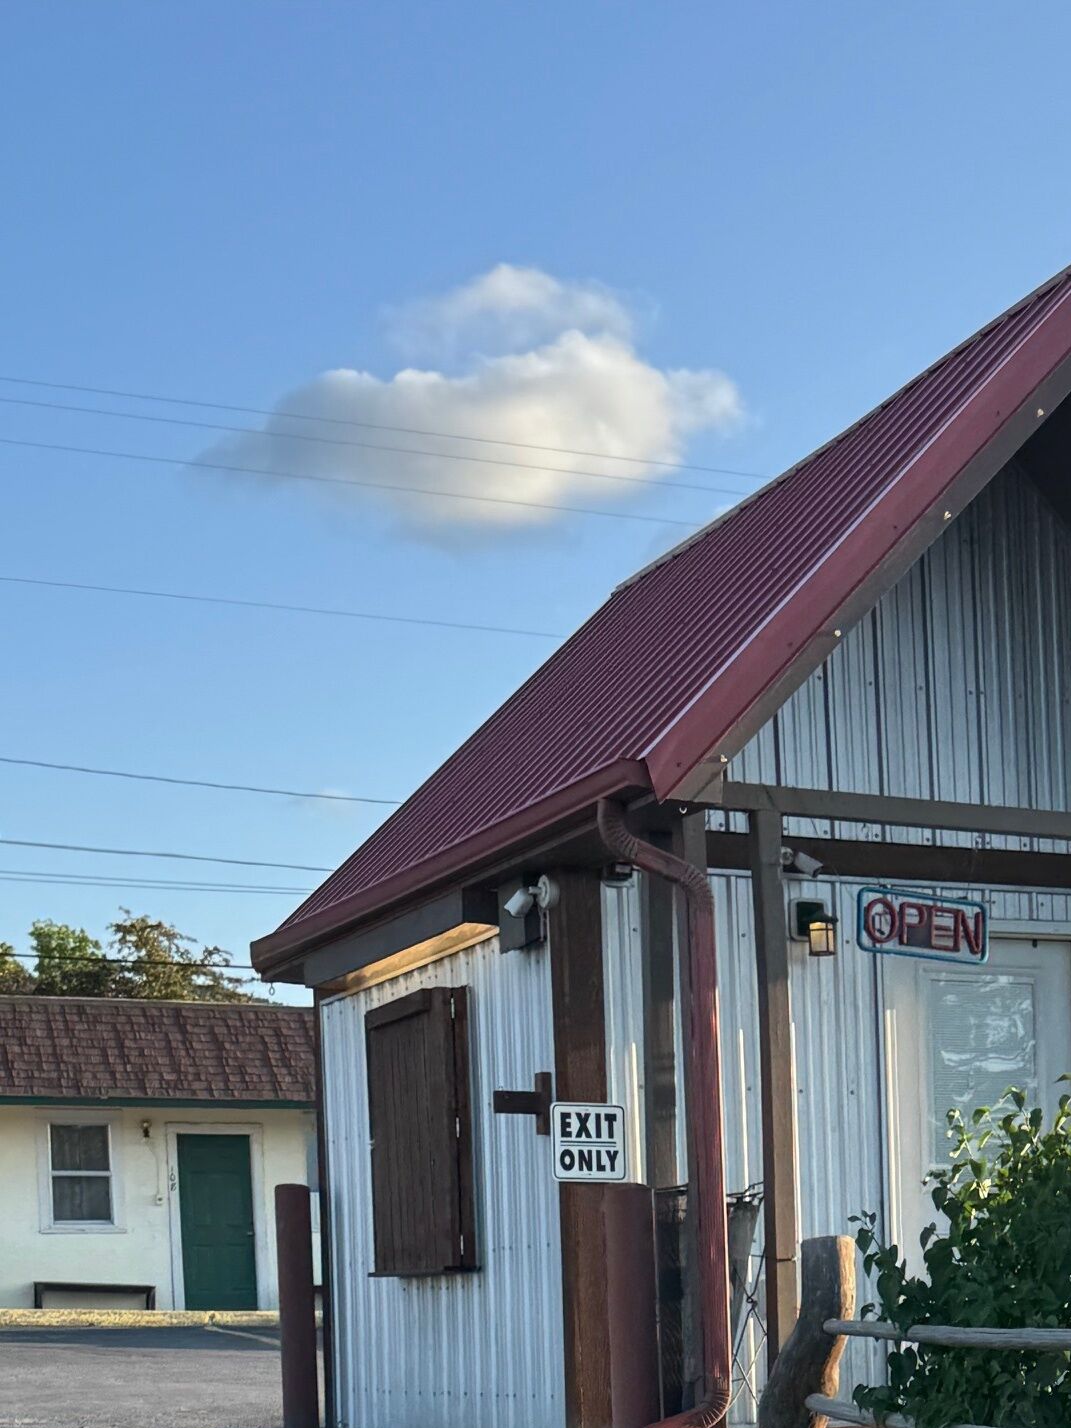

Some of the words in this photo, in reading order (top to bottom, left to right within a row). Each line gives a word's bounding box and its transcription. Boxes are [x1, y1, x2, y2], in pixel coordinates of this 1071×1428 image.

[864, 898, 983, 955] OPEN
[560, 1112, 617, 1139] EXIT
[560, 1148, 619, 1172] ONLY
